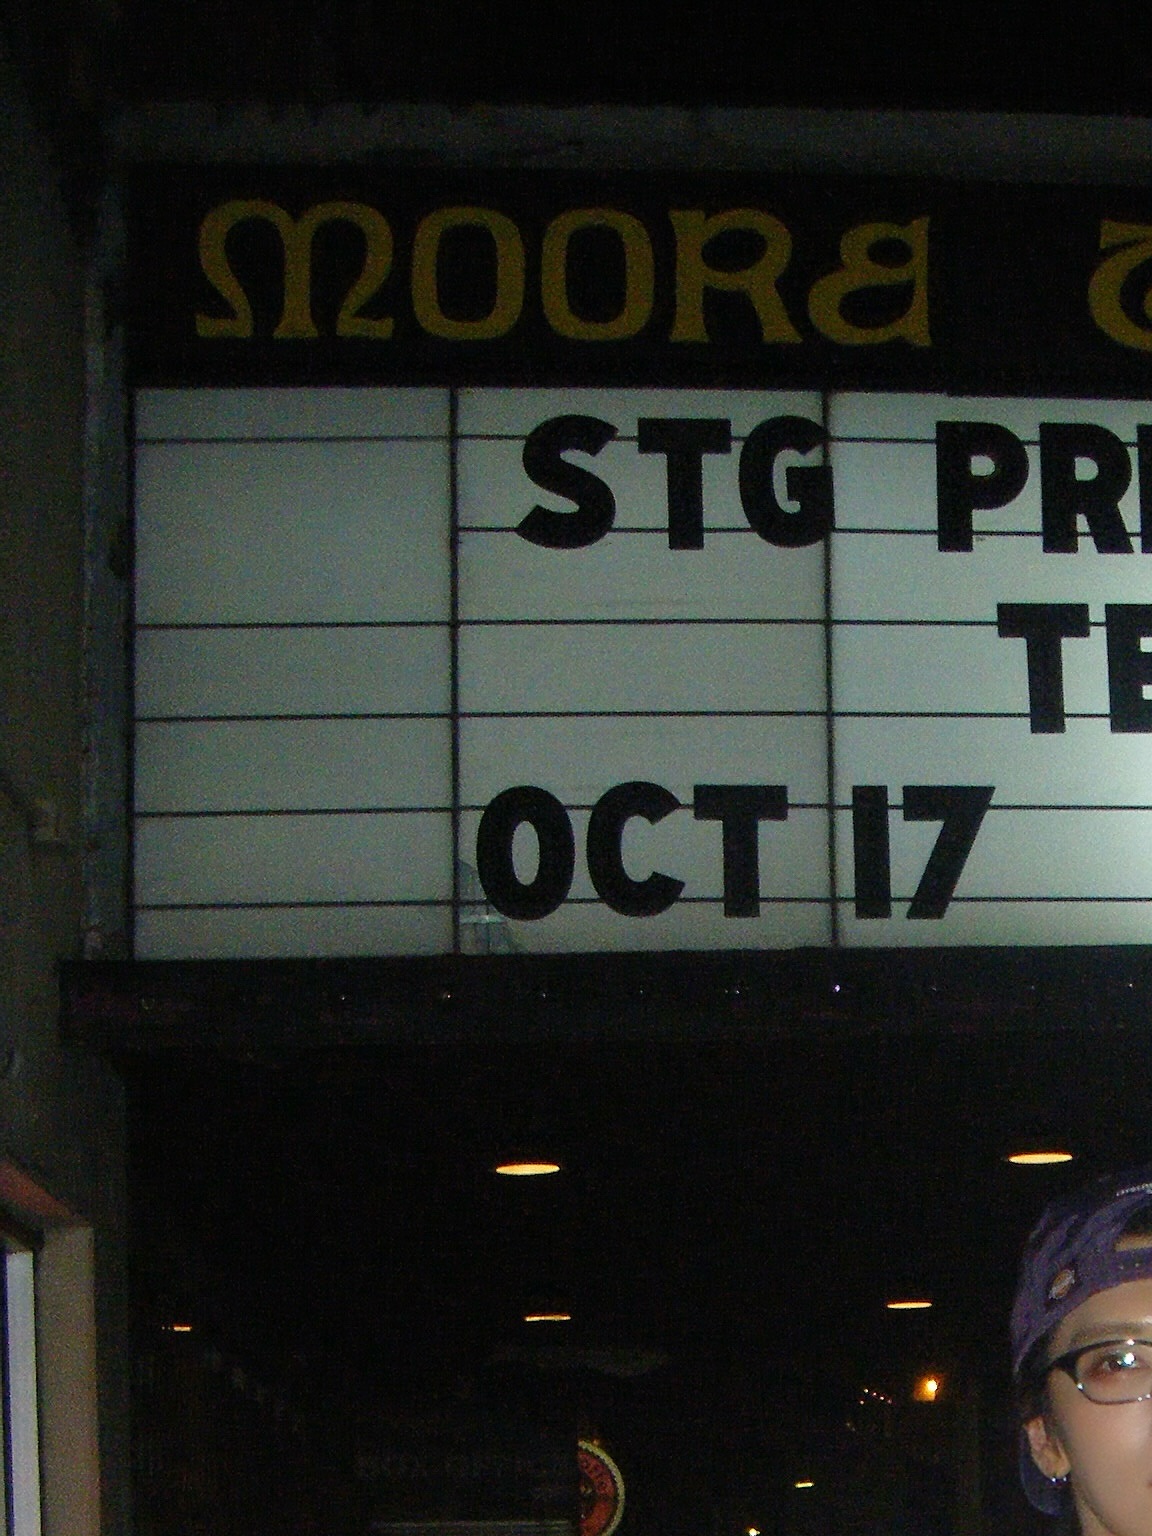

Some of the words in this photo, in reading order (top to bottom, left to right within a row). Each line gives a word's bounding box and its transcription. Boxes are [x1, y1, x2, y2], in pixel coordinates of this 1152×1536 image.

[196, 200, 933, 347] MOORE
[515, 414, 835, 549] STG
[476, 781, 788, 920] OCT
[852, 785, 995, 920] 17
